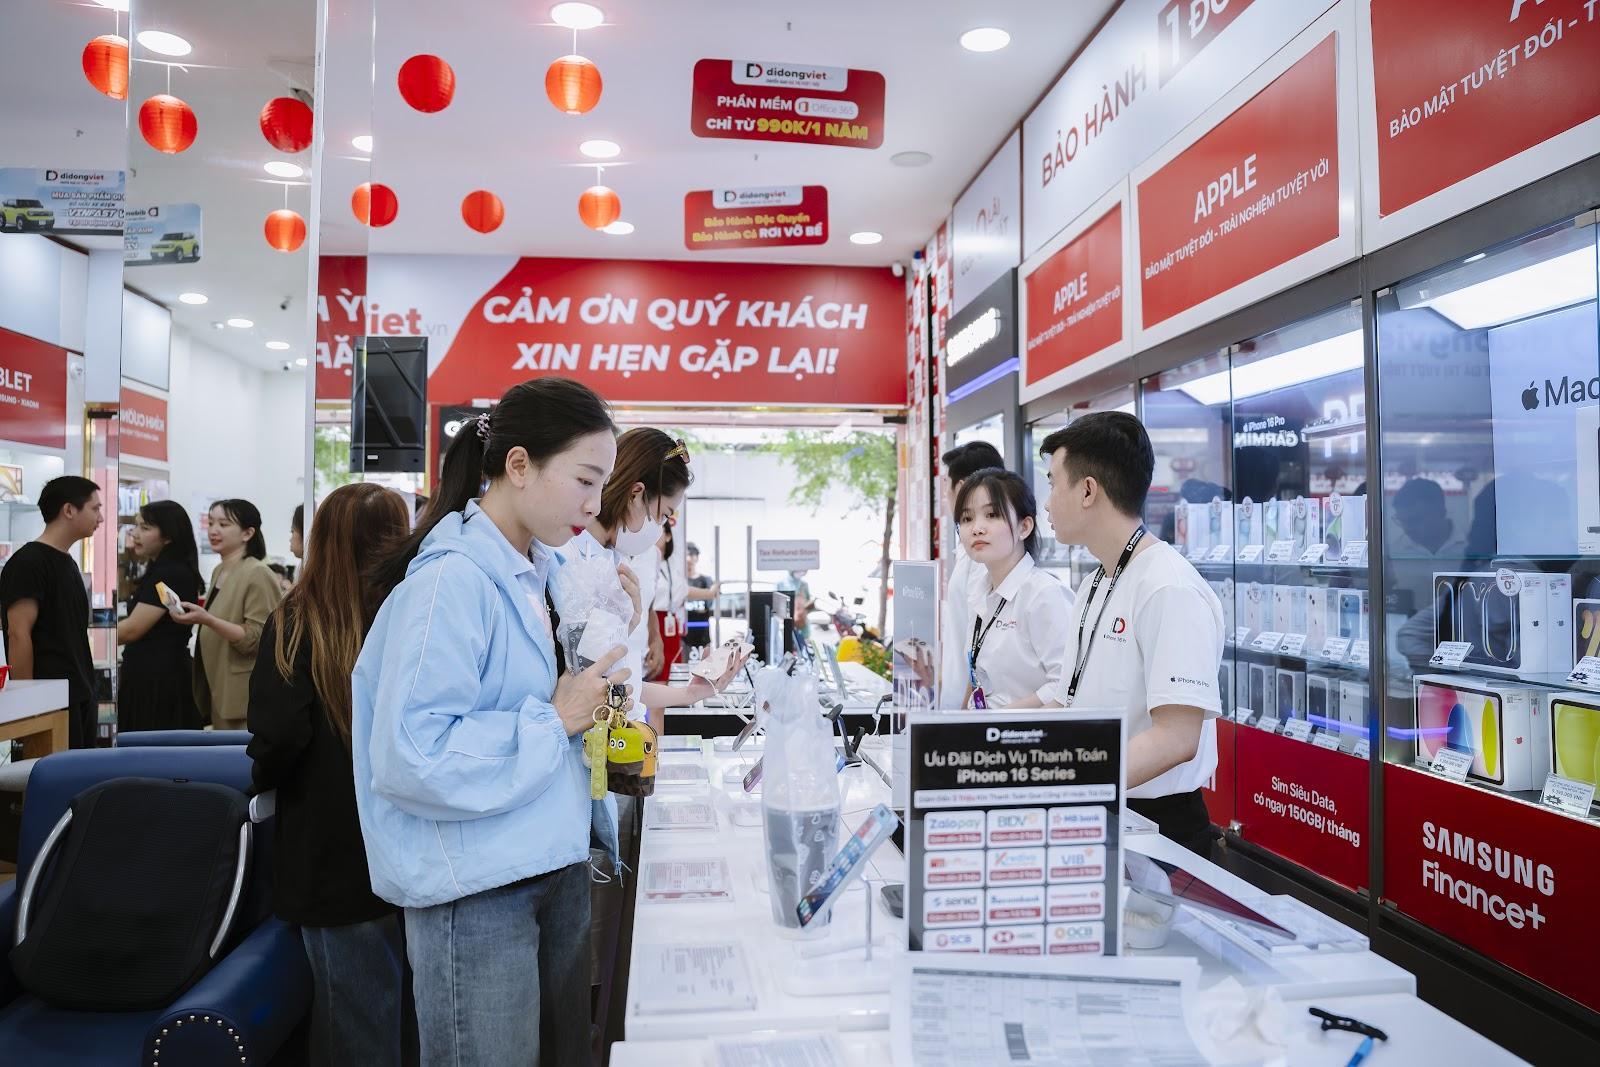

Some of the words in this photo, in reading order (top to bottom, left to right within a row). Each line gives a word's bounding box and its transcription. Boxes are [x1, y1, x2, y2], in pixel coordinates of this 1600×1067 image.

[766, 67, 827, 80] didongviet
[1389, 107, 1421, 138] BẢO
[1423, 83, 1457, 119] MẬT
[1460, 45, 1520, 95] TUYỆT
[1523, 16, 1562, 60] ĐỐI
[706, 116, 732, 130] CHỈ
[734, 117, 757, 131] TỪ
[757, 118, 821, 136] 990K/1
[1042, 126, 1079, 188] BẢO
[1085, 50, 1147, 146] HÀNH
[60, 172, 104, 181] didongviet
[739, 190, 786, 200] didongviet
[1193, 153, 1257, 224] APPLE
[68, 208, 117, 218] VINFAST
[1145, 261, 1159, 280] BẢO
[1159, 252, 1174, 271] MẬT
[1175, 238, 1198, 258] TUYỆT
[1199, 229, 1213, 249] ĐỐI
[1219, 213, 1238, 237] TRẢI
[1238, 193, 1275, 226] NGHIỆM
[1276, 172, 1308, 203] TUYỆT
[483, 286, 570, 324] CẢM
[580, 293, 636, 324] ƠN
[647, 291, 731, 330] QUÝ
[736, 294, 868, 331] KHÁCH
[1053, 271, 1088, 314] APPLE
[512, 342, 581, 371] XIN
[590, 343, 669, 379] HẸN
[679, 338, 758, 381] GẶP
[767, 347, 839, 381] LẠI!
[957, 768, 1007, 784] iPhone
[1010, 768, 1027, 782] 16
[1030, 767, 1076, 781] Series
[973, 749, 1006, 768] Dịch
[1008, 750, 1027, 766] Vụ
[1030, 748, 1073, 764] Thanh
[1076, 746, 1108, 762] Toán
[1271, 776, 1289, 795] Sim
[1289, 782, 1310, 803] Siêu
[1311, 790, 1338, 816] Data,
[1253, 791, 1264, 806] có
[1265, 797, 1287, 818] ngay
[1287, 803, 1325, 834] 150GB/
[1326, 819, 1361, 848] tháng
[1422, 821, 1555, 897] SAMSUNG
[1422, 859, 1546, 931] Finance+
